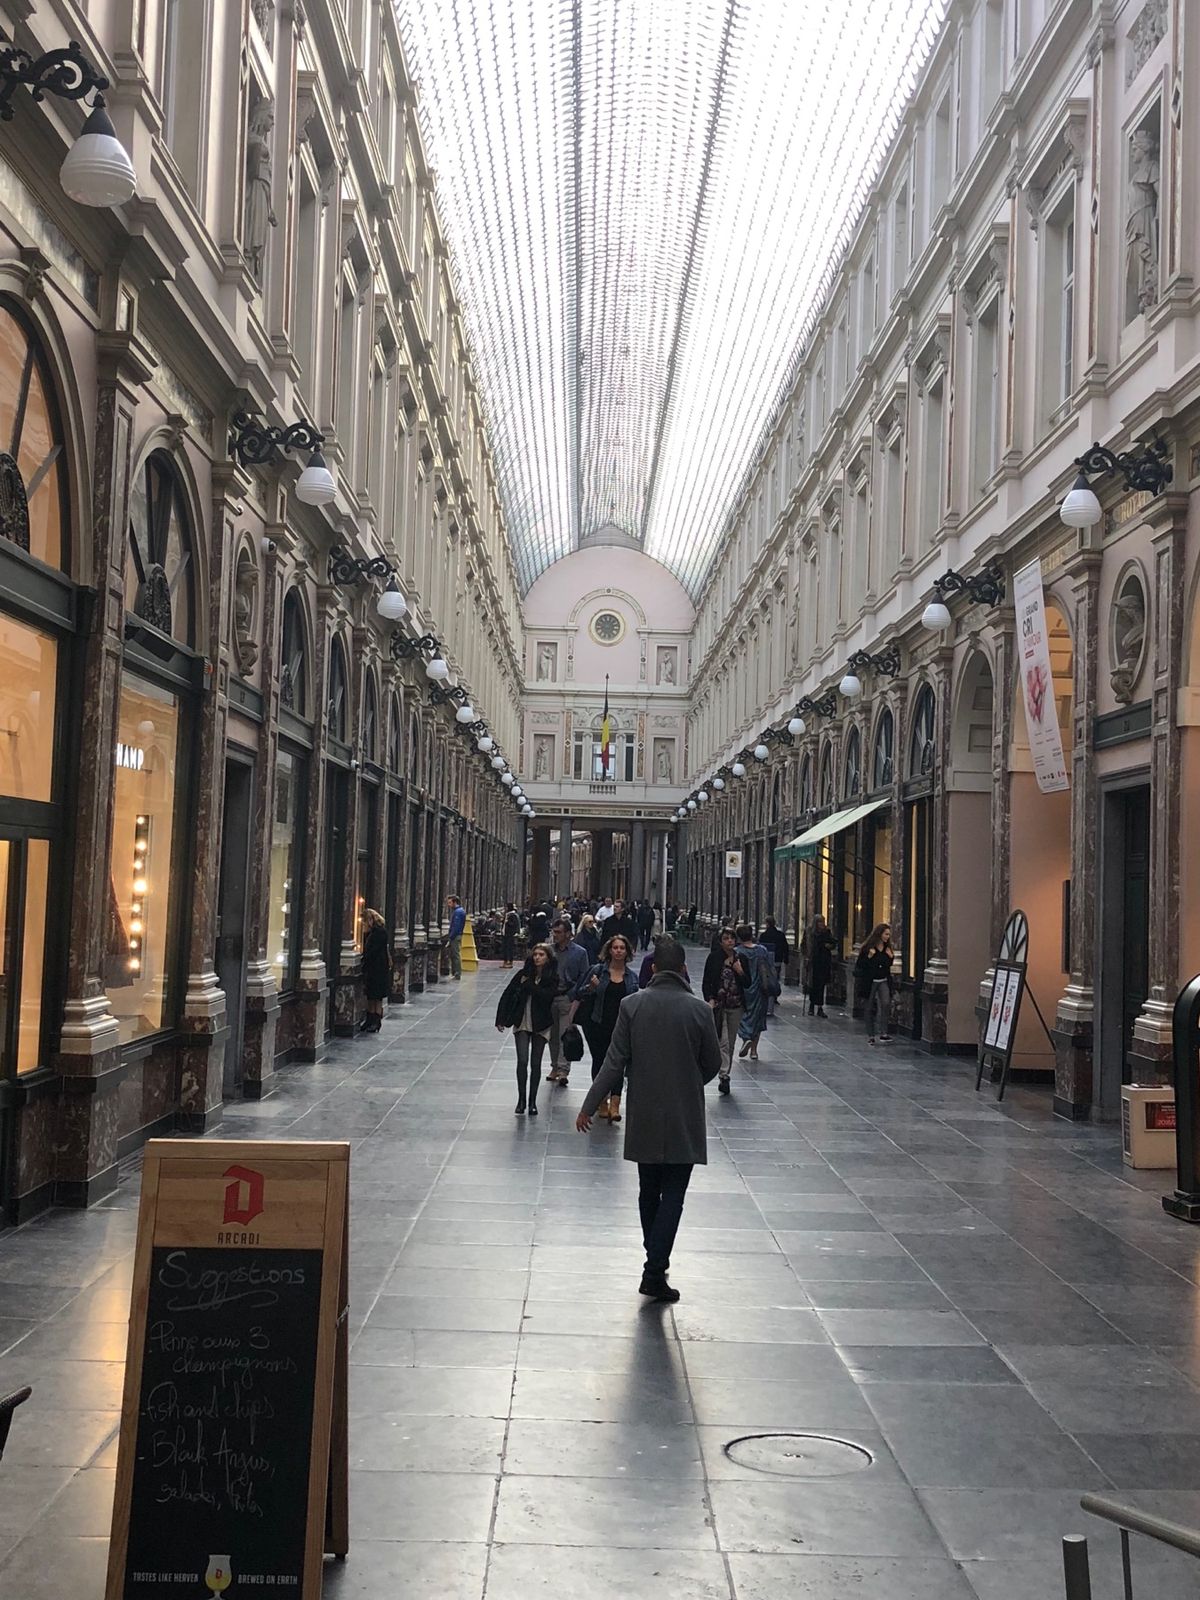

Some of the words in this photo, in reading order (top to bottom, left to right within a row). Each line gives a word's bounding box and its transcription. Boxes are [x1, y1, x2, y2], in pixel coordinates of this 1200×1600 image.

[1022, 616, 1034, 638] CRI
[217, 1231, 261, 1246] ARCADI
[158, 1250, 306, 1311] Suggestions
[150, 1320, 199, 1352] Penne
[248, 1326, 271, 1350] 3
[183, 1385, 219, 1419] and
[132, 1571, 157, 1583] TASTES
[158, 1572, 173, 1583] LIKE
[174, 1573, 199, 1584] HEAVEN
[238, 1573, 265, 1584] BREWED
[266, 1574, 277, 1584] ON
[278, 1575, 299, 1585] EARTH
